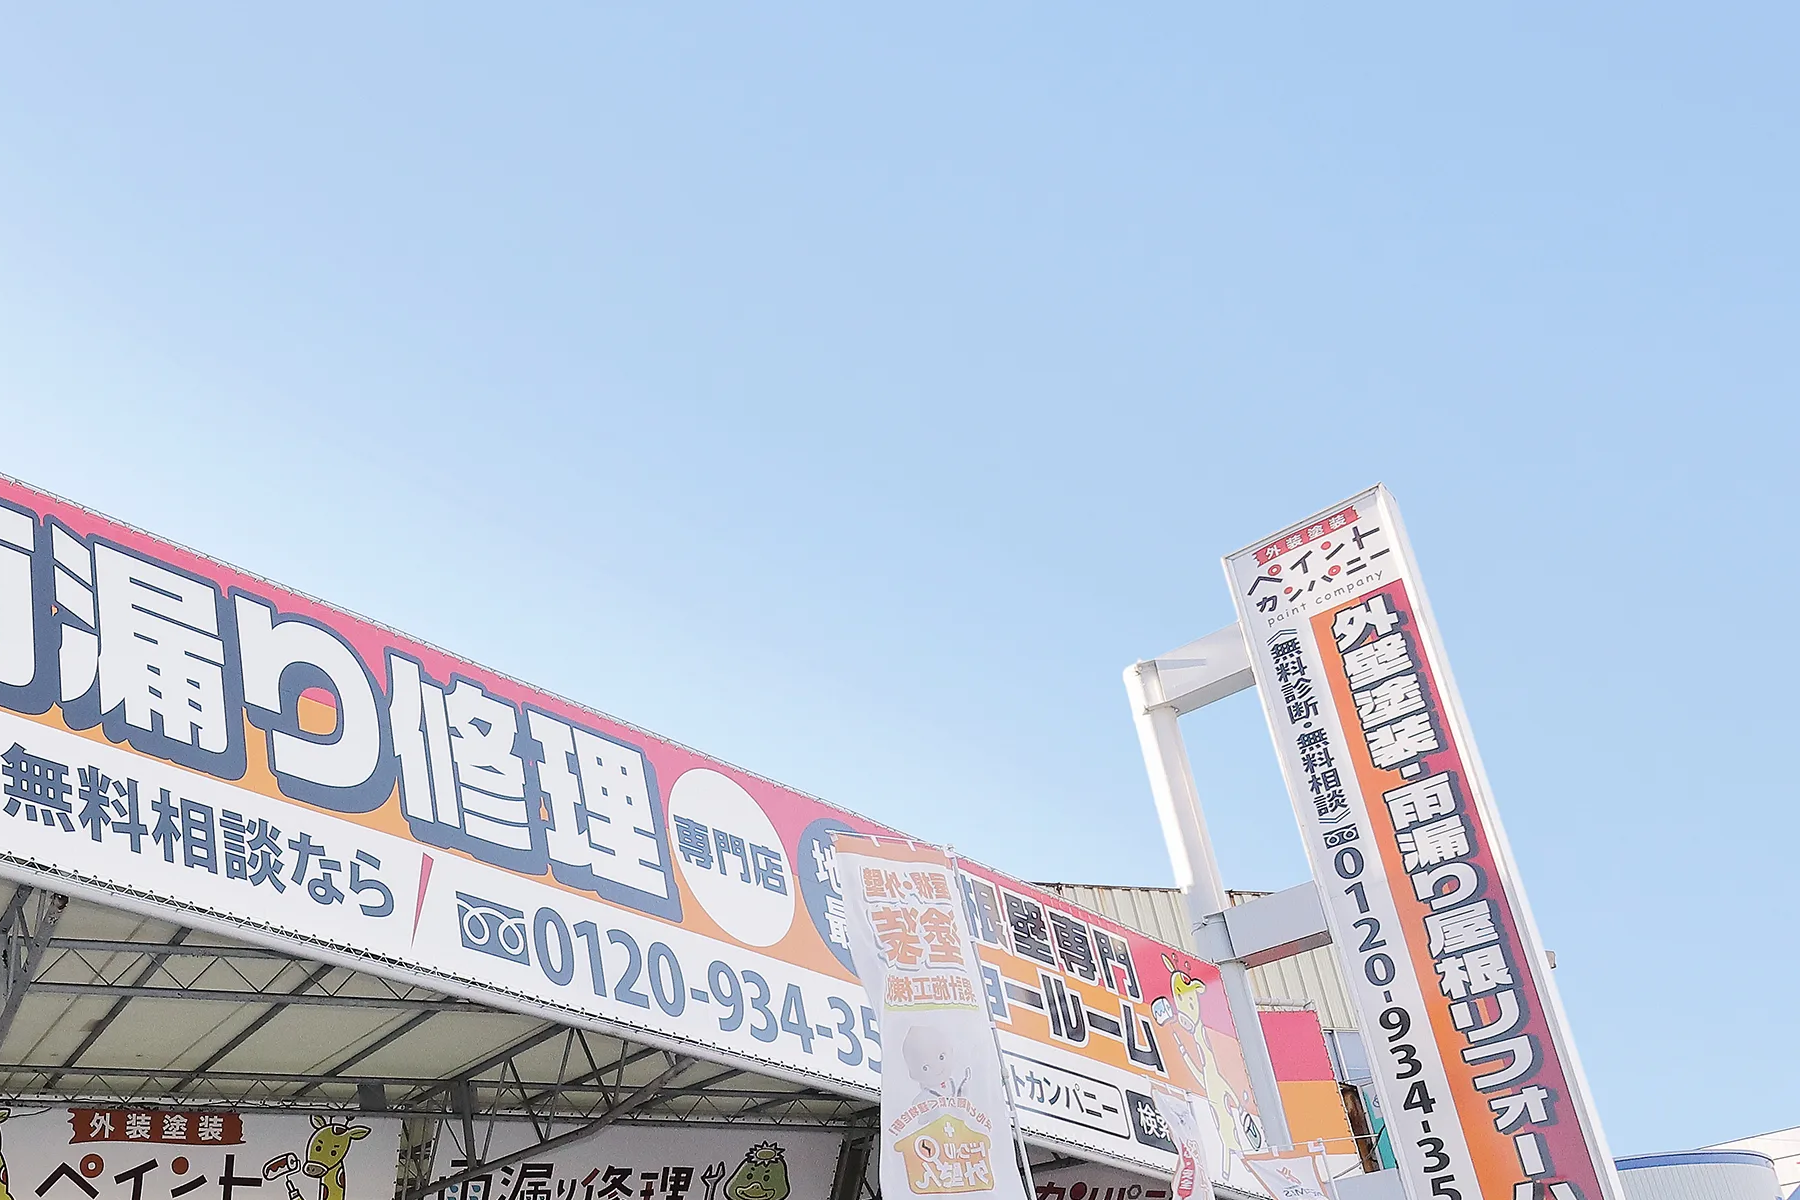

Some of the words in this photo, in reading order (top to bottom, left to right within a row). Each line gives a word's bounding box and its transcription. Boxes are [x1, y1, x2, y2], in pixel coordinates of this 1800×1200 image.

[1247, 526, 1380, 596] ペイント
[1265, 514, 1347, 560] 外装塗装
[1256, 548, 1390, 613] カンパニー
[1268, 602, 1308, 627] paint
[1315, 569, 1383, 605] company
[674, 818, 789, 897] 専門店
[533, 906, 882, 1073] 0120-934-35
[1009, 1063, 1119, 1118] トカンパニー
[89, 1112, 225, 1141] 外装塗装
